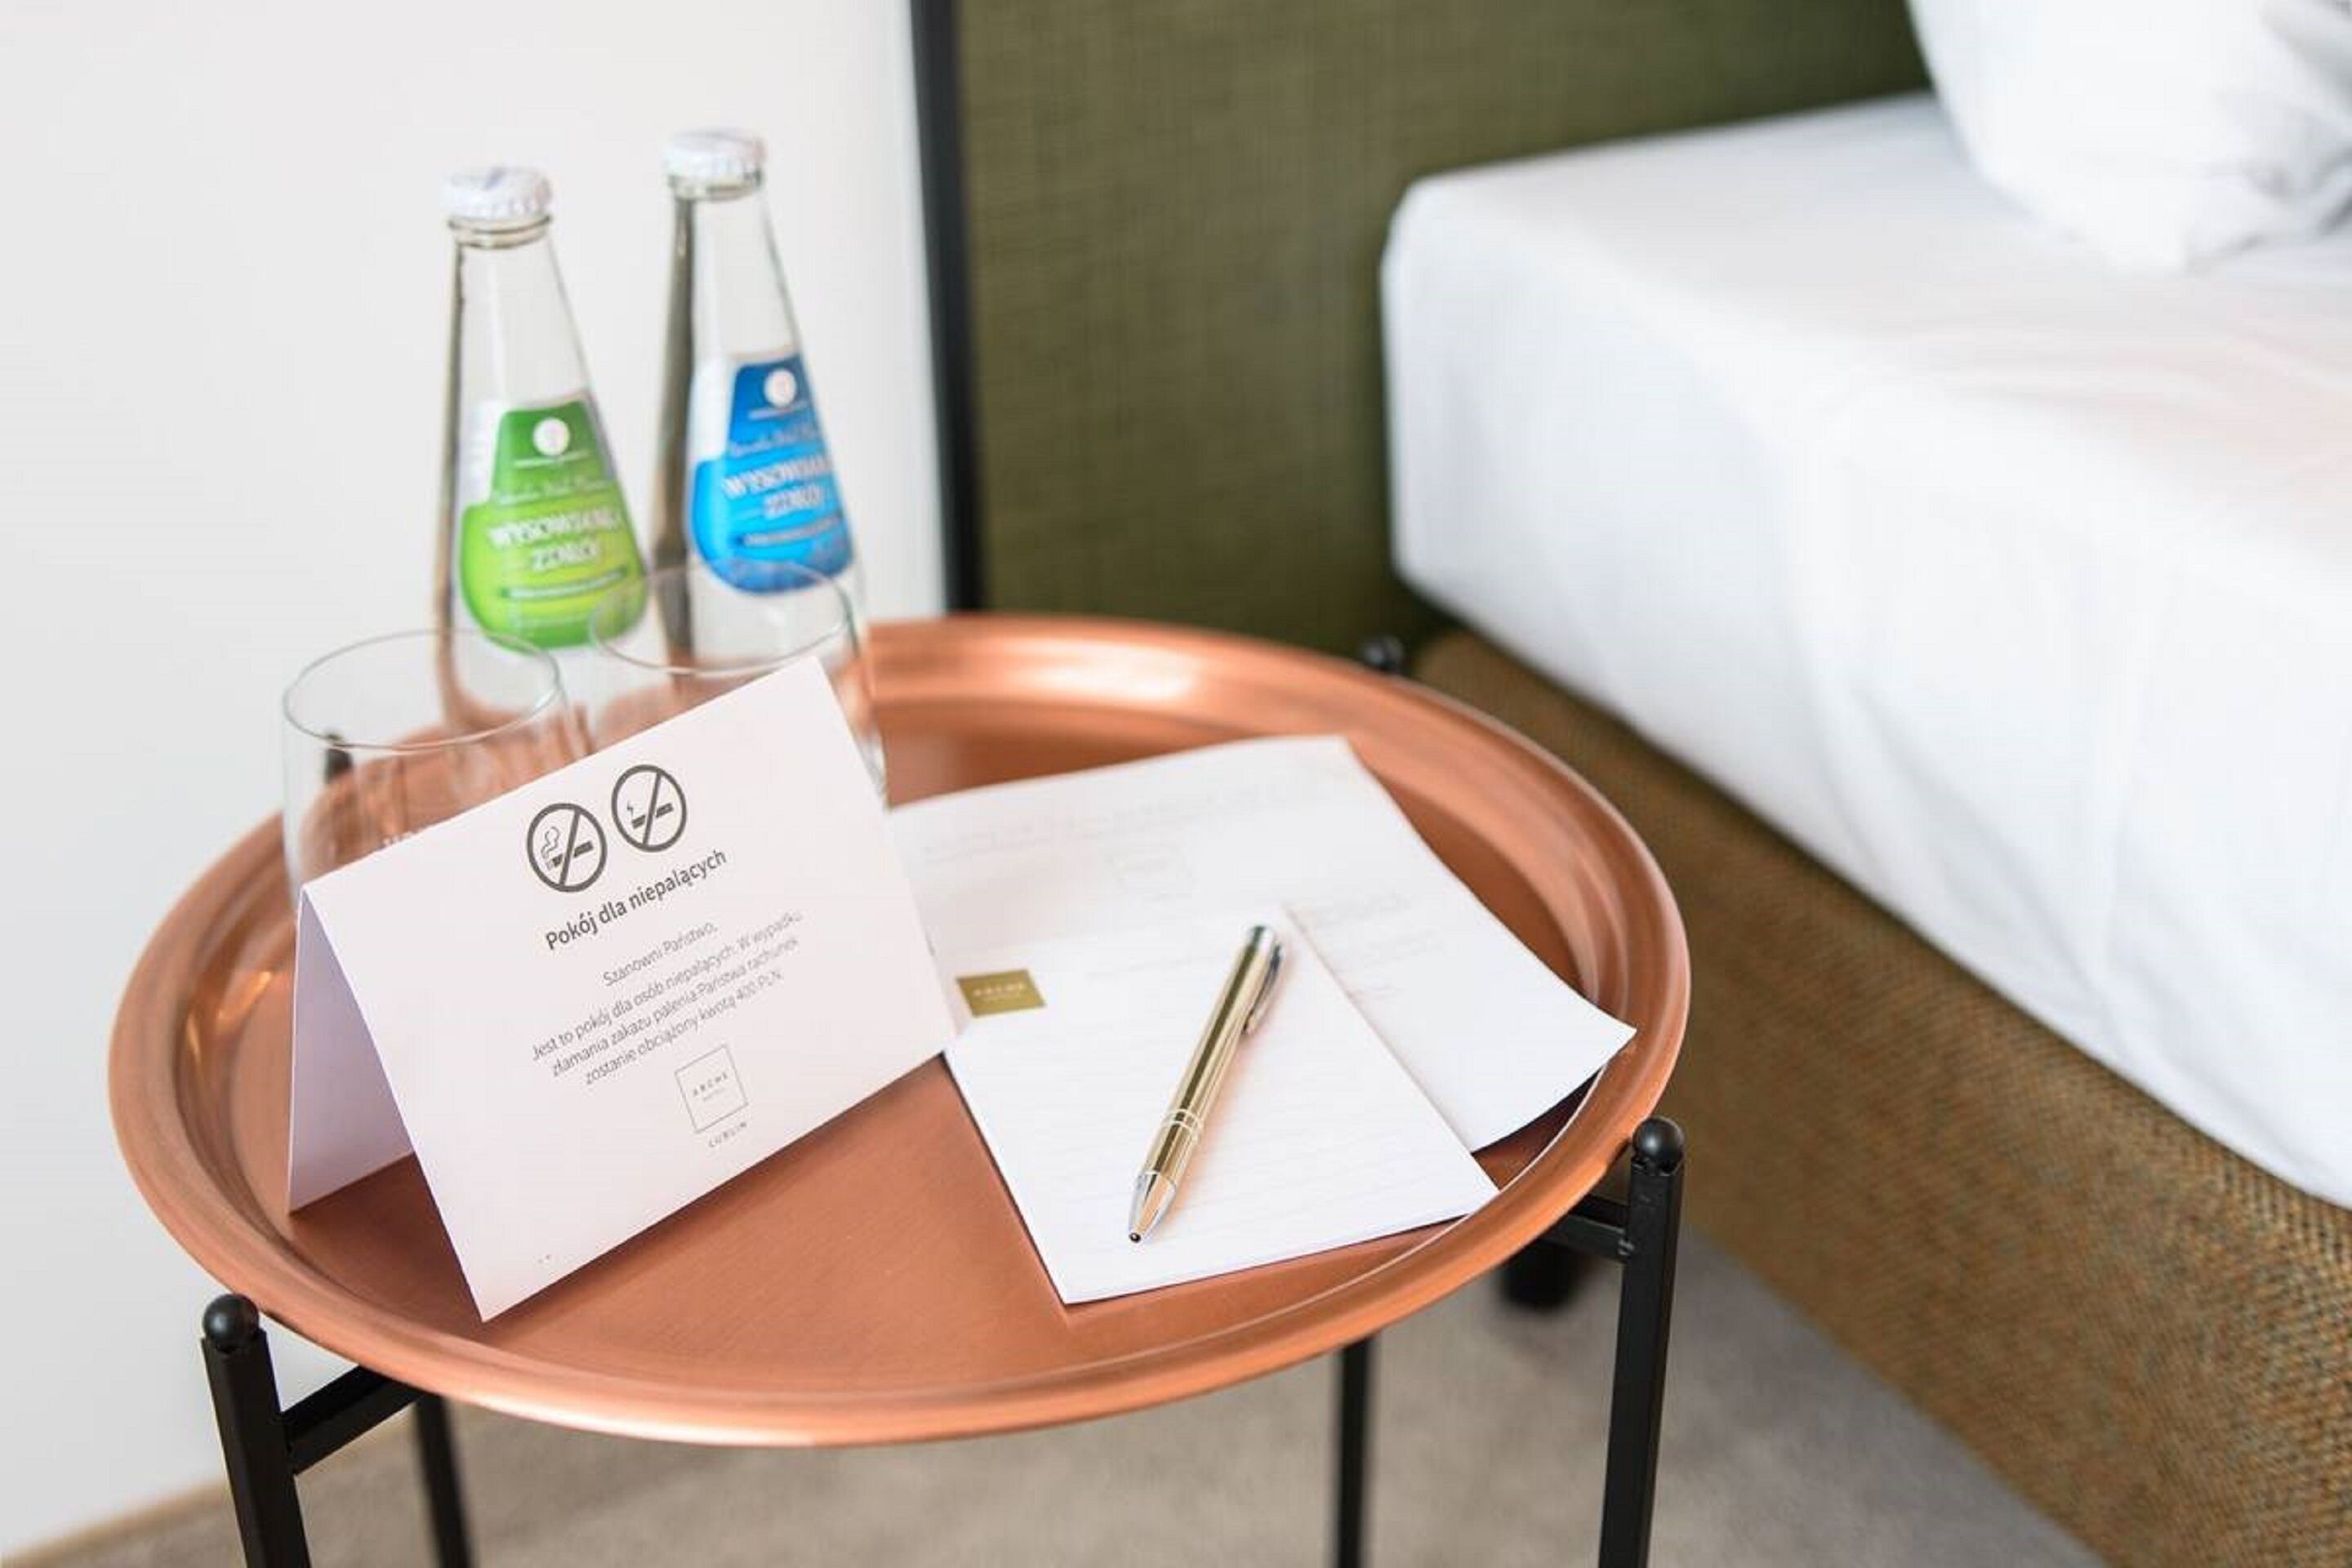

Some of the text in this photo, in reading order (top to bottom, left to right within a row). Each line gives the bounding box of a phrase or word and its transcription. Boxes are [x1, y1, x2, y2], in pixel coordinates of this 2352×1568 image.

[546, 849, 727, 950] Pokój dla niepalących
[603, 949, 663, 987] Szanowni
[532, 1038, 559, 1061] Jest
[559, 1031, 572, 1046] to
[574, 1007, 612, 1040] pokój
[612, 1000, 633, 1018] dla
[633, 980, 665, 1006] osób
[554, 1038, 609, 1077] złamania
[611, 1016, 652, 1046] zakazu
[653, 989, 698, 1024] palenia
[586, 1049, 637, 1085] zostanie
[637, 1016, 699, 1055] obciążony
[698, 995, 737, 1020] kwotą
